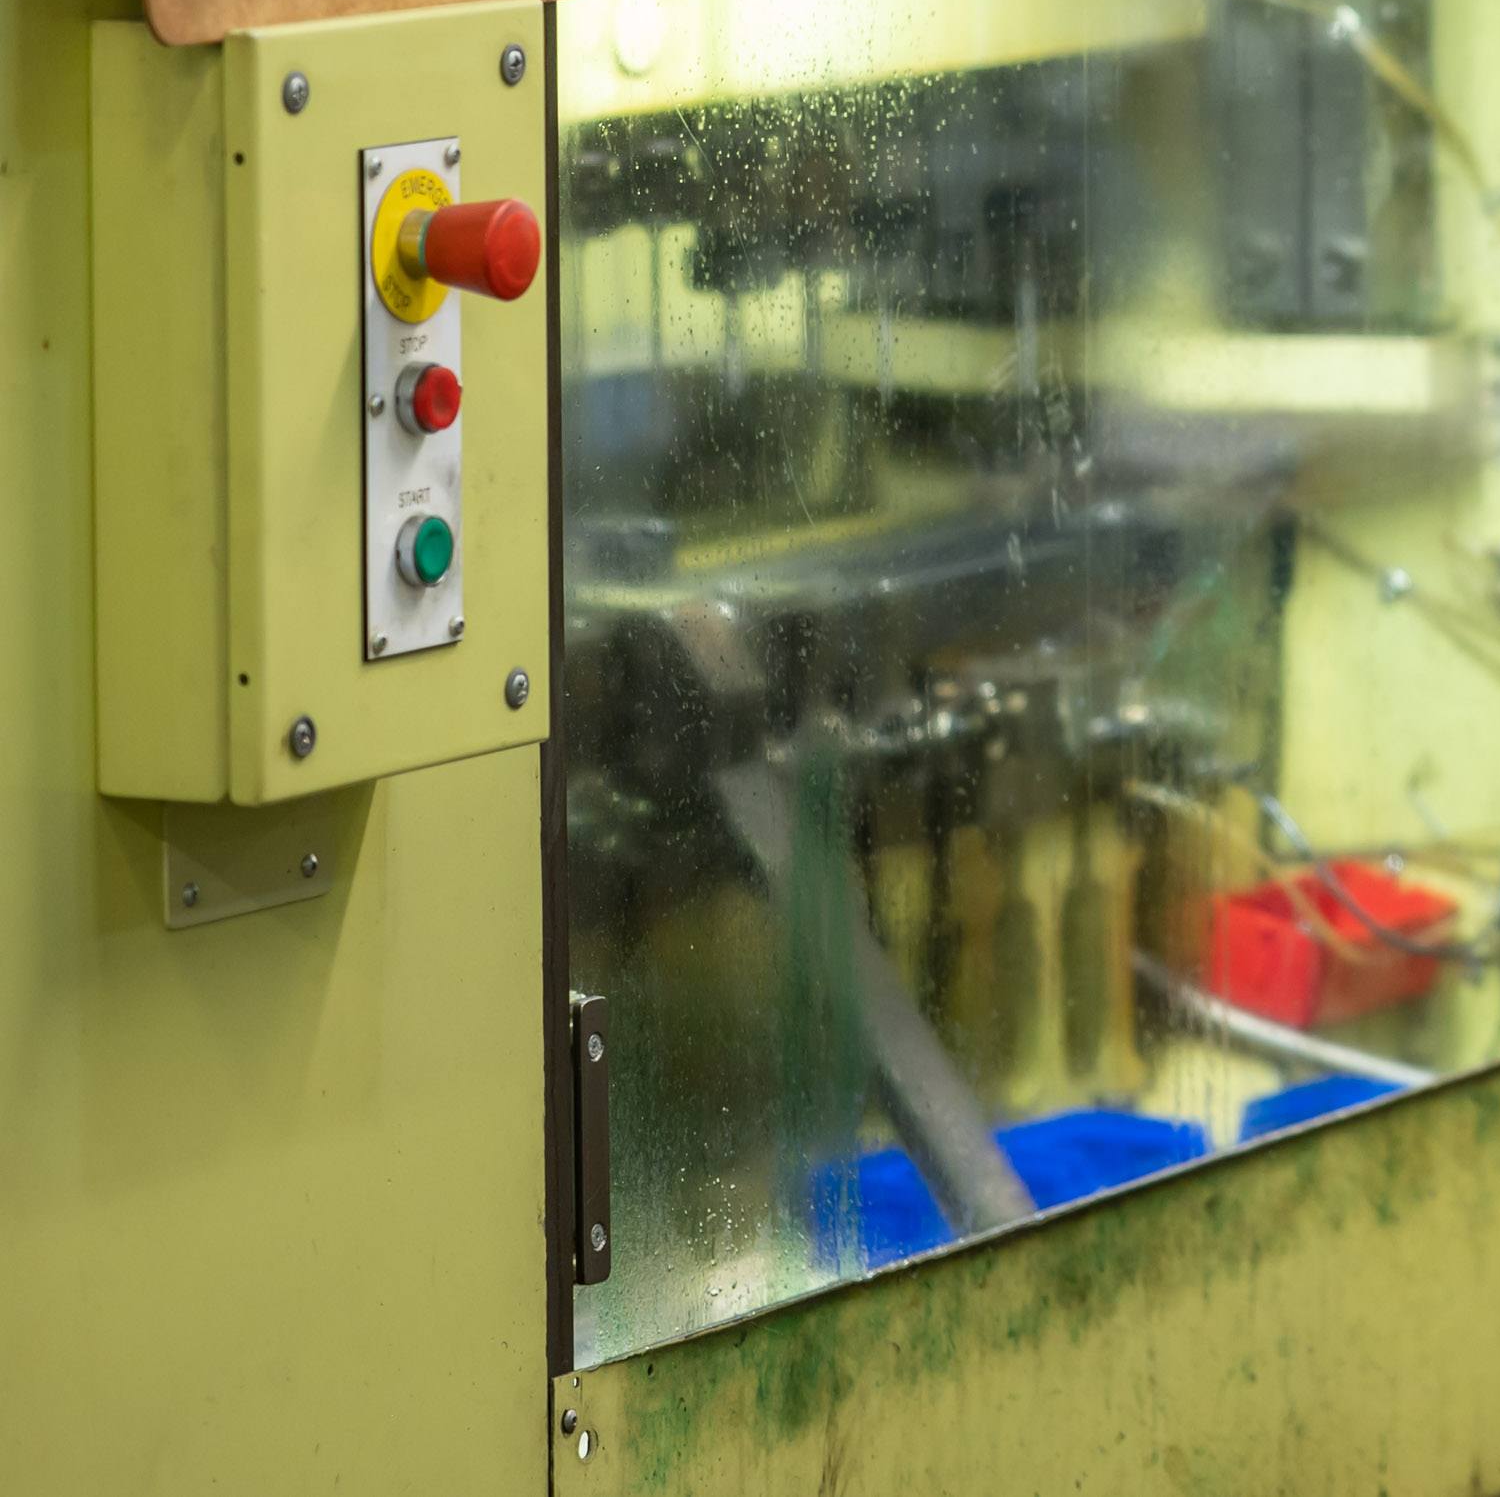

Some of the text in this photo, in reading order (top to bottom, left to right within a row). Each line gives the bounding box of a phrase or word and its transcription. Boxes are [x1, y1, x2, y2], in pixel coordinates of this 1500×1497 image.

[382, 274, 412, 311] STOP
[399, 334, 428, 354] STOP
[398, 487, 431, 508] START
